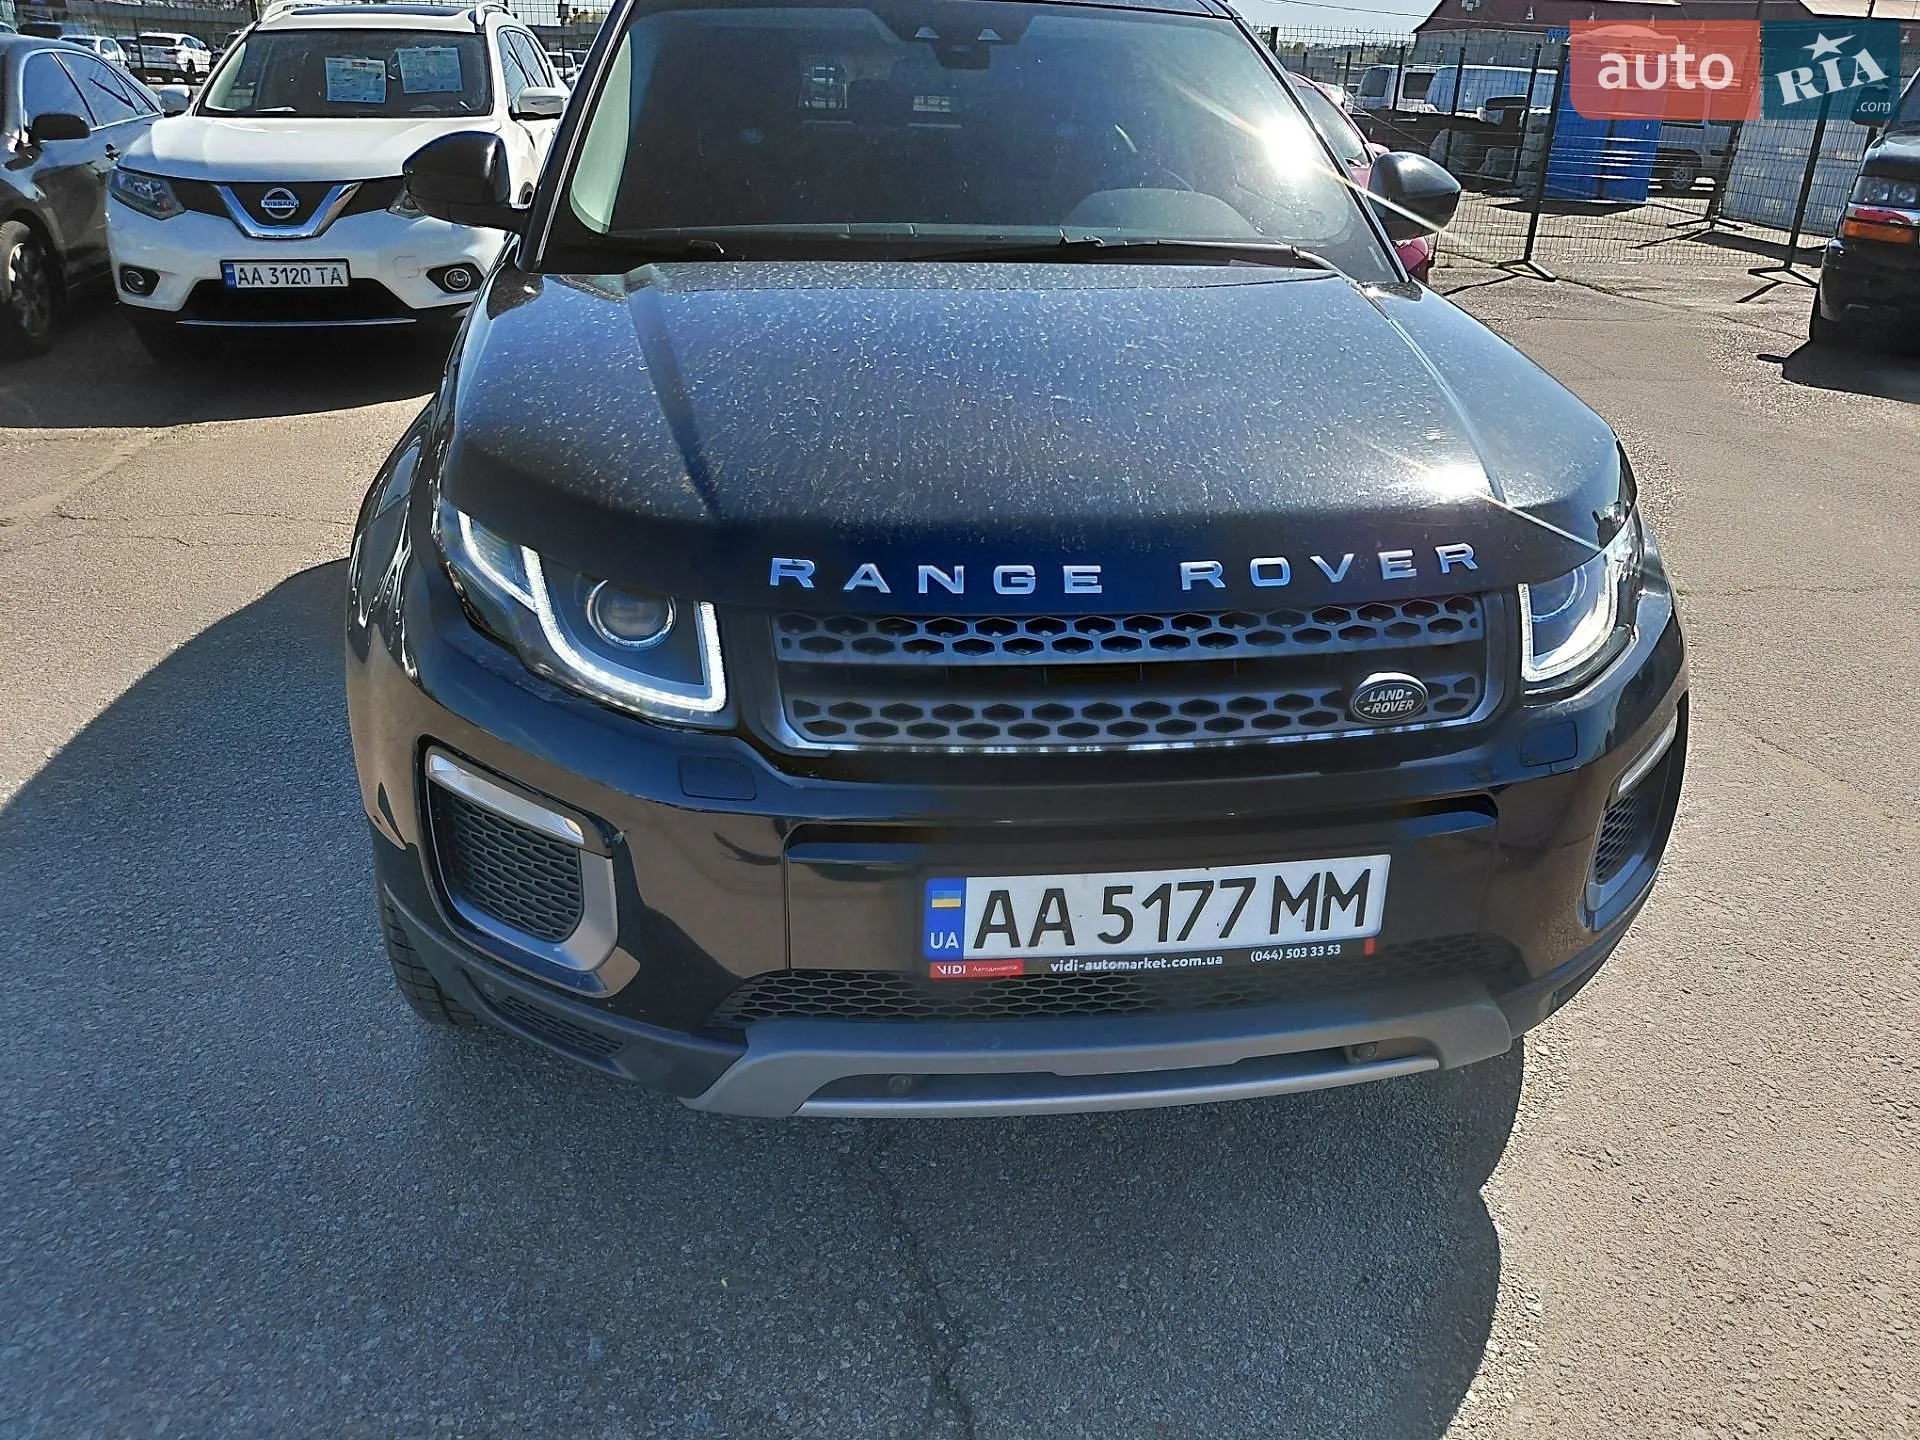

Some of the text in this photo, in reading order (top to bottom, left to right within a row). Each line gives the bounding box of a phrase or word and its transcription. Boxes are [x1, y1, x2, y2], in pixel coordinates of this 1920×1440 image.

[238, 267, 343, 285] AA 3120 TA
[769, 542, 1479, 596] RANGE ROVER
[1368, 688, 1405, 702] LAND
[1370, 699, 1415, 714] ROVER
[972, 868, 1372, 950] AA 5177 MM
[930, 931, 960, 950] UA
[1250, 944, 1342, 963] (044) 503 33 53
[936, 964, 967, 975] VIDI
[1050, 955, 1223, 973] vidi-automarket.com.ua
